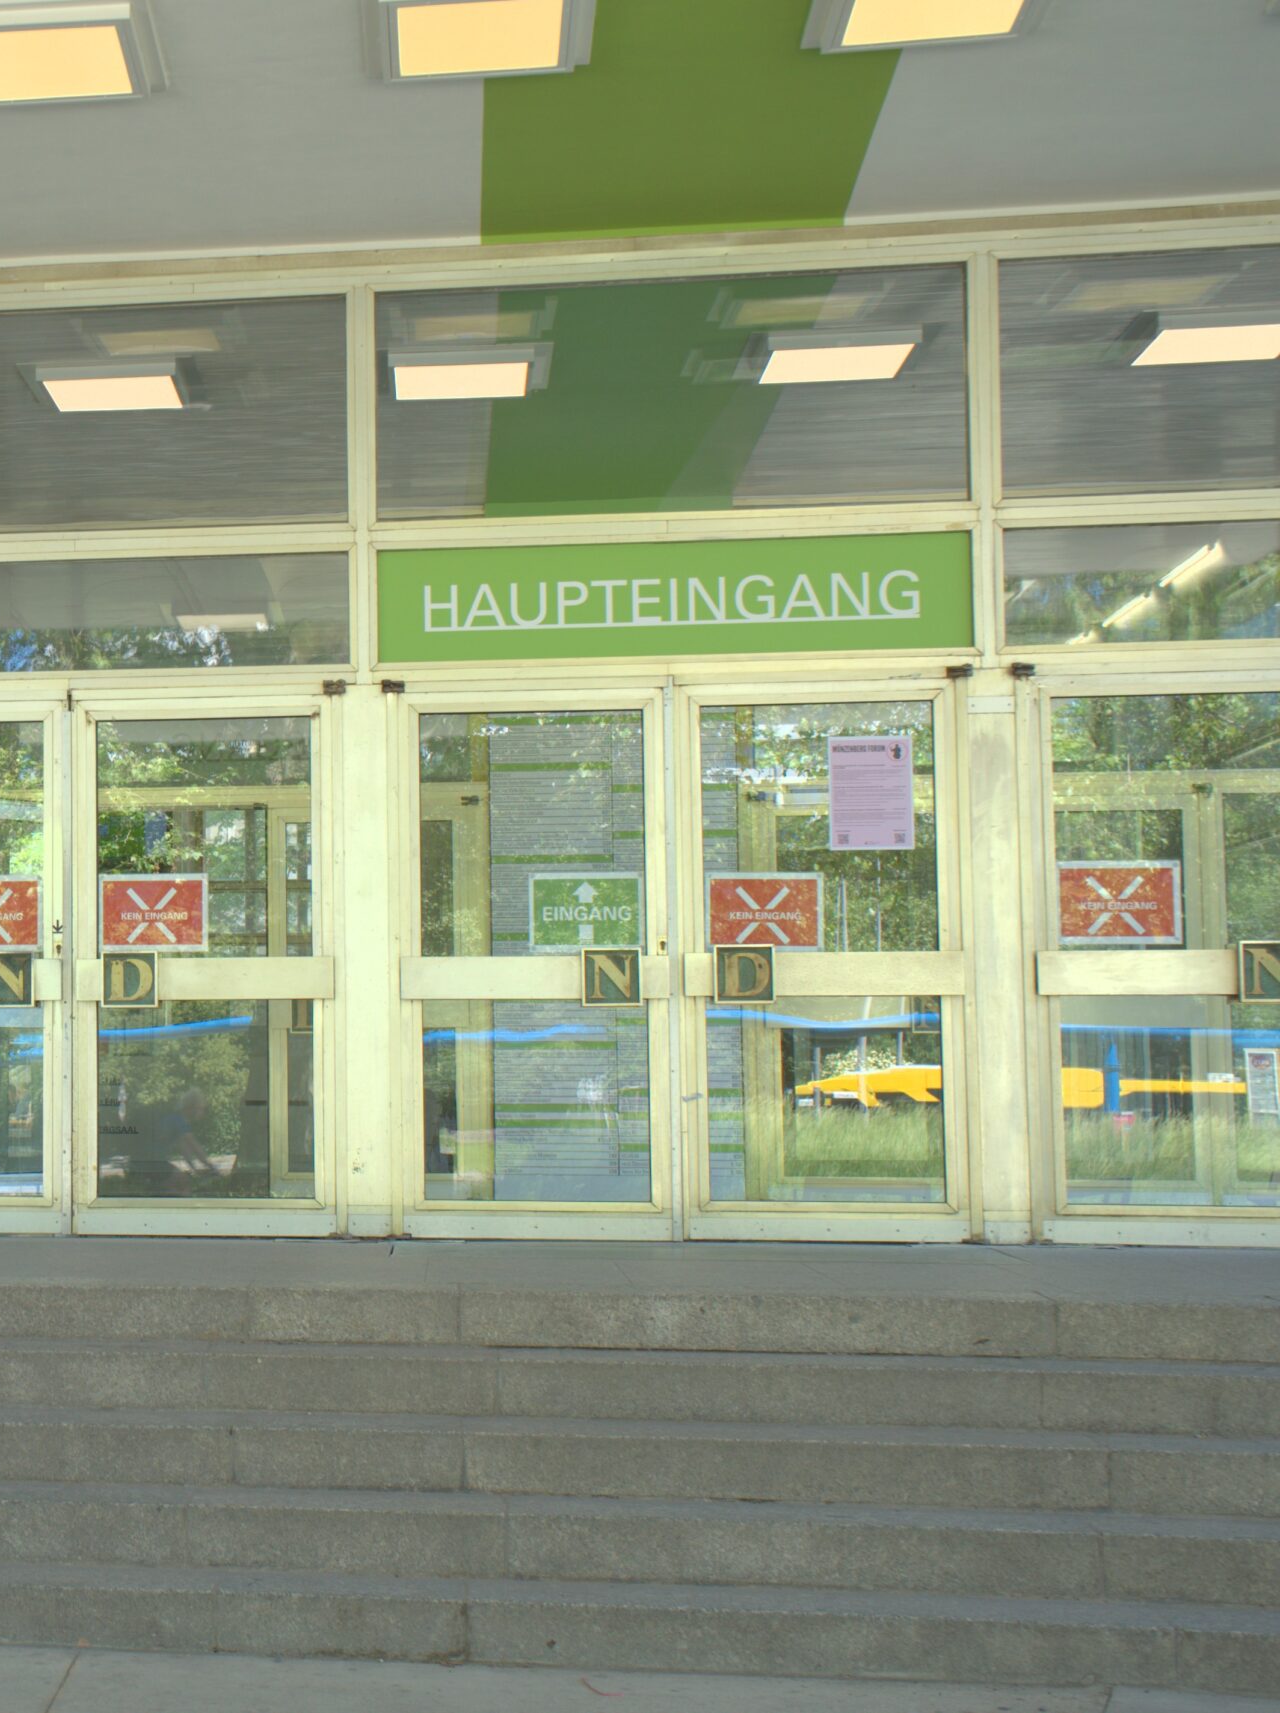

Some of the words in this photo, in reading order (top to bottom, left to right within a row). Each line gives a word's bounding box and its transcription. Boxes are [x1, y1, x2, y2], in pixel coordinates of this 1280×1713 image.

[423, 569, 921, 632] HAUPTEINGANG
[120, 911, 143, 921] KEIN
[144, 911, 189, 921] EINGANG
[542, 905, 632, 921] EINGANG
[729, 911, 753, 921] KEIN
[755, 911, 802, 921] EINGANG
[1080, 901, 1105, 910] KEIN
[1107, 901, 1158, 910] EINGANG
[109, 958, 153, 1002] D
[588, 954, 633, 999] N
[721, 952, 770, 997] D
